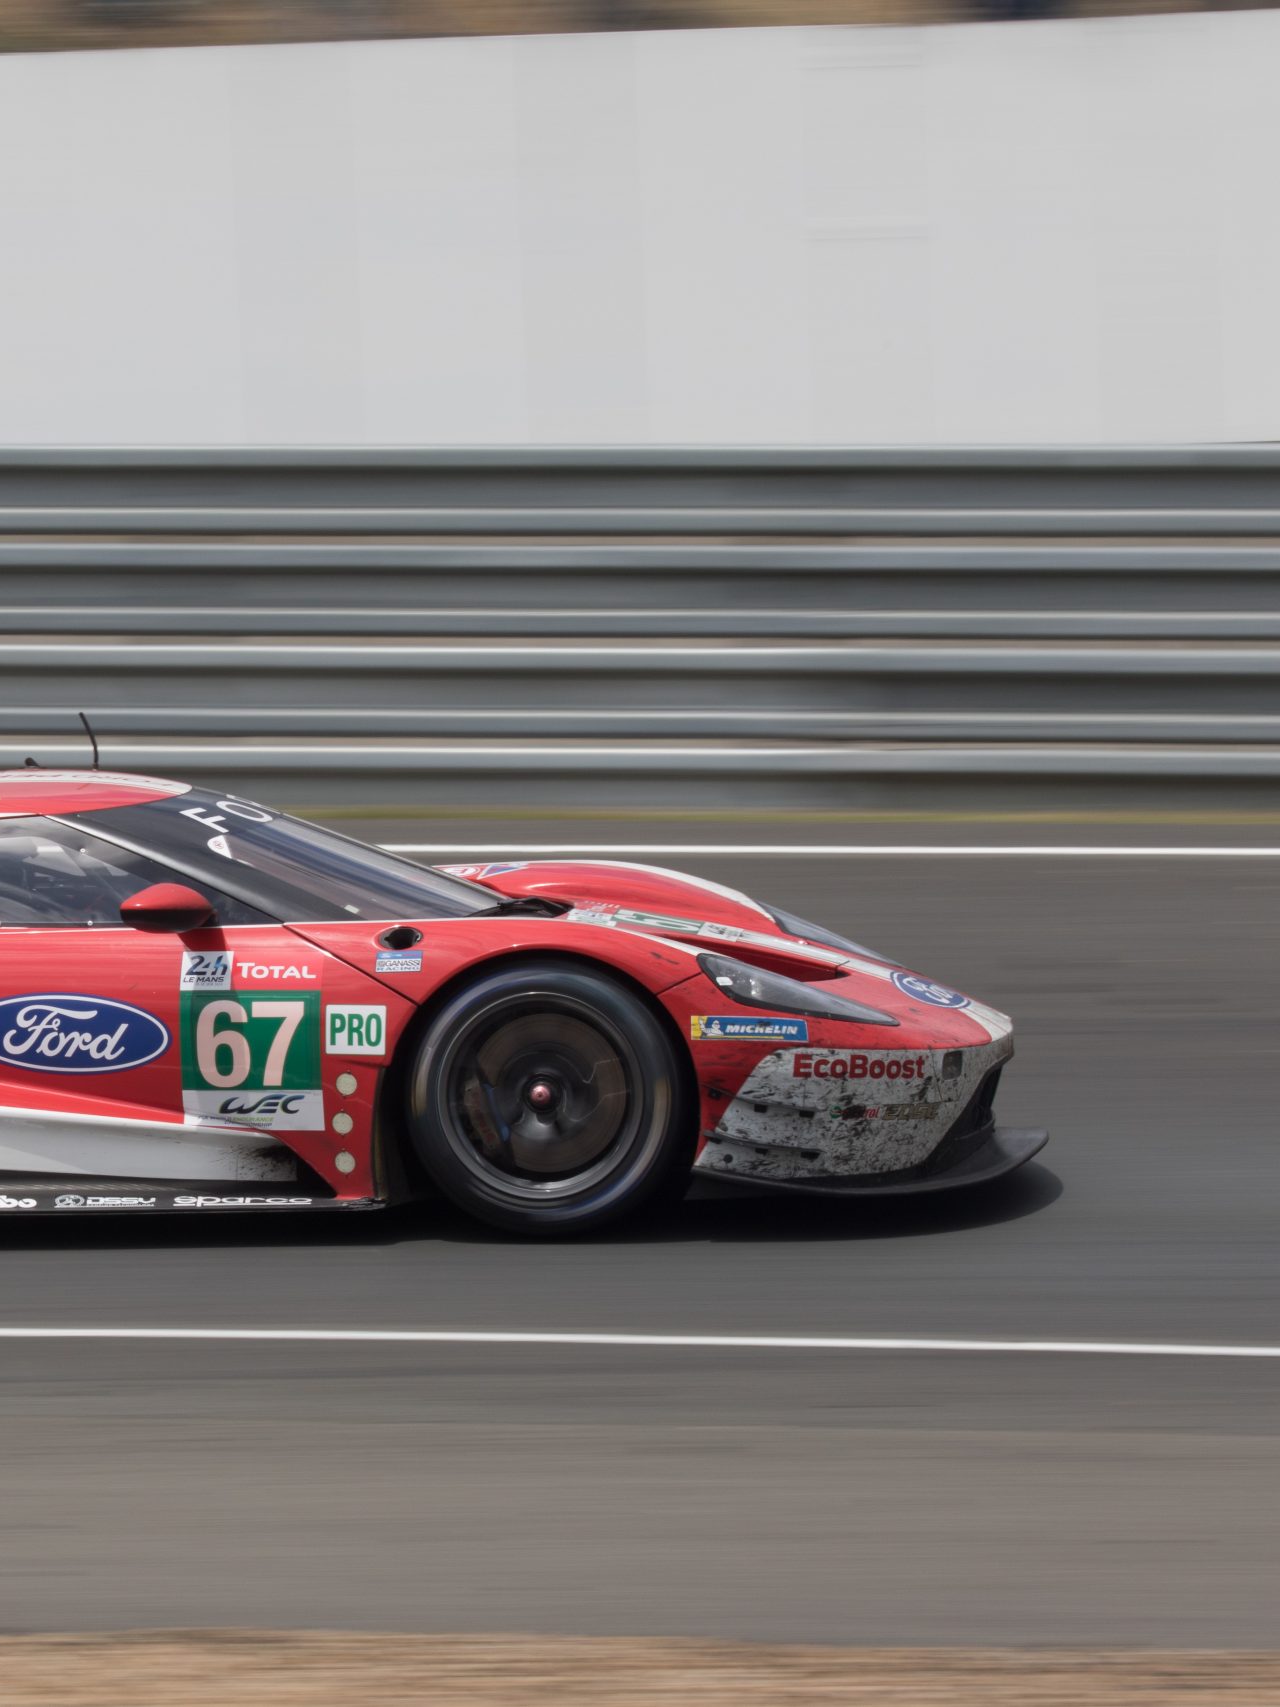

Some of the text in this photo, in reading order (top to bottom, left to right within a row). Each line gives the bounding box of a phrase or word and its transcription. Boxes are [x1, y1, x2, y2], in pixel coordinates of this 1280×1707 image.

[236, 962, 317, 979] TOTAL
[2, 1004, 129, 1061] Ford
[329, 1012, 383, 1048] PRO
[725, 1024, 799, 1035] MICHELIN
[195, 999, 305, 1088] 67
[792, 1053, 926, 1080] EcoBoost
[218, 1093, 305, 1115] WEC
[173, 1195, 313, 1207] sparco
